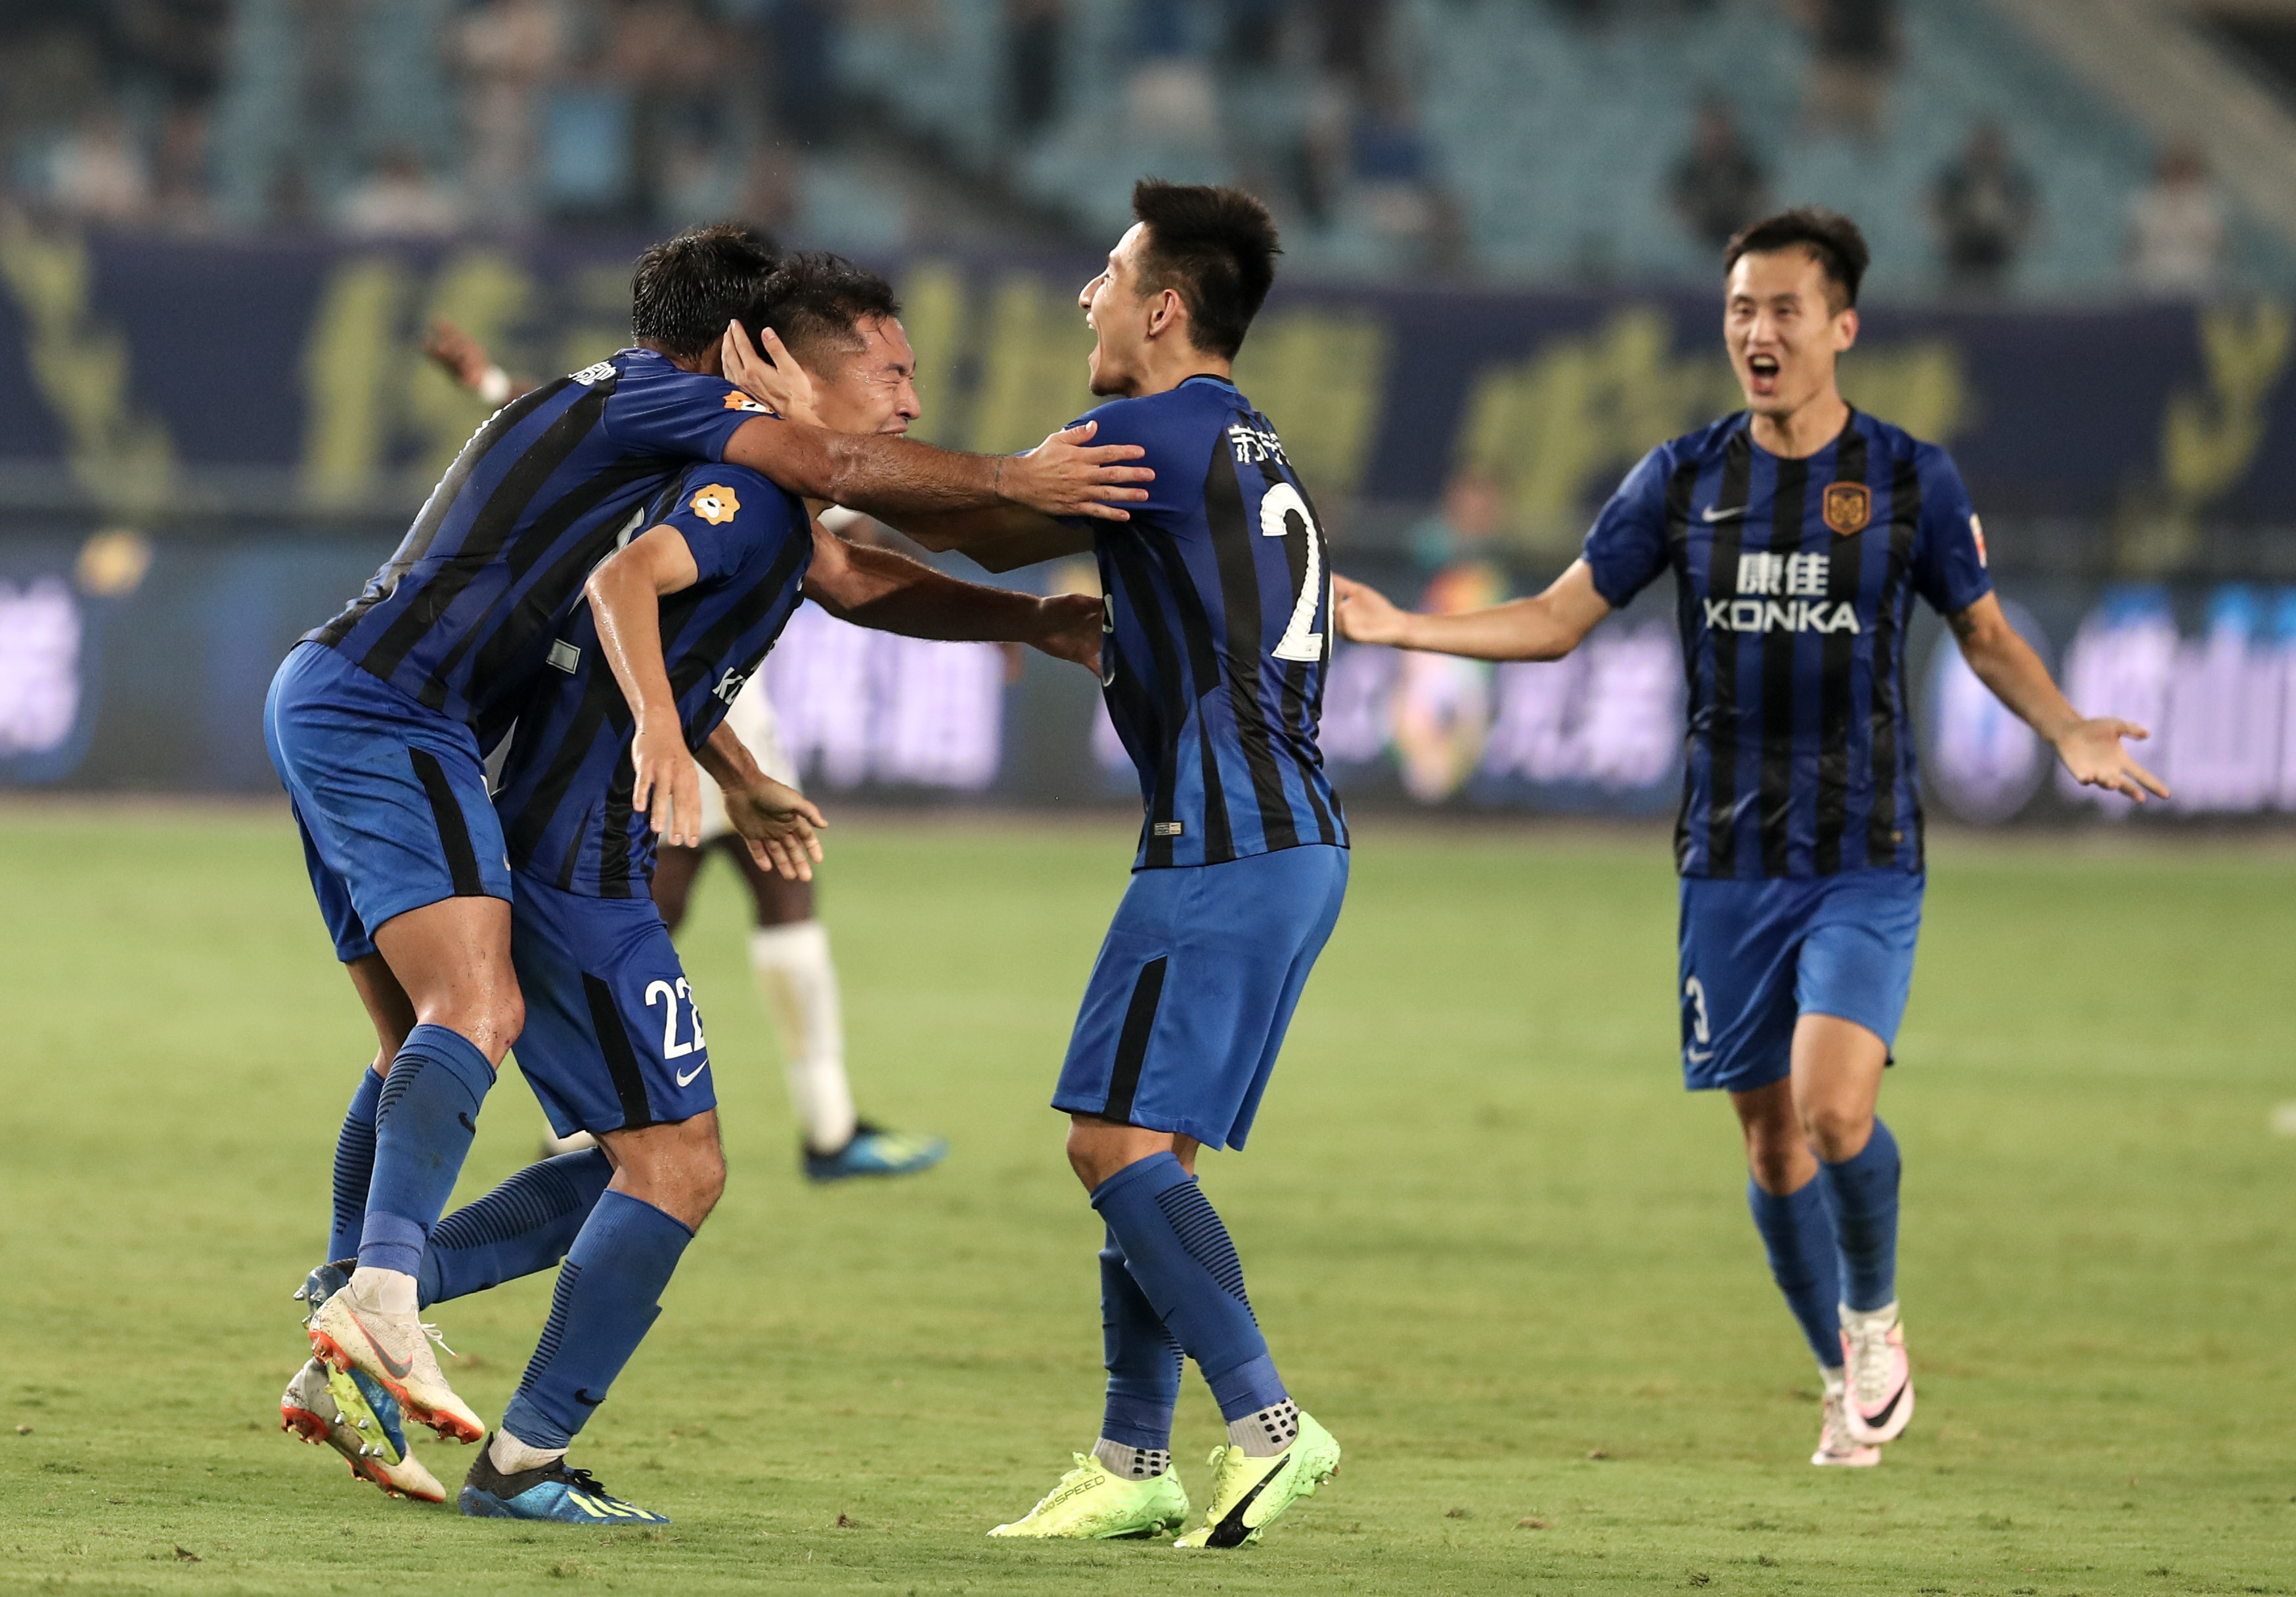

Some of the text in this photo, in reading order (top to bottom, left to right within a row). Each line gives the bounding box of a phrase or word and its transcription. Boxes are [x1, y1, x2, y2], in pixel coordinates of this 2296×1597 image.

[1736, 551, 1830, 596] 康佳
[1703, 597, 1861, 634] KONKA
[645, 976, 706, 1059] 22
[1685, 975, 1710, 1044] 3
